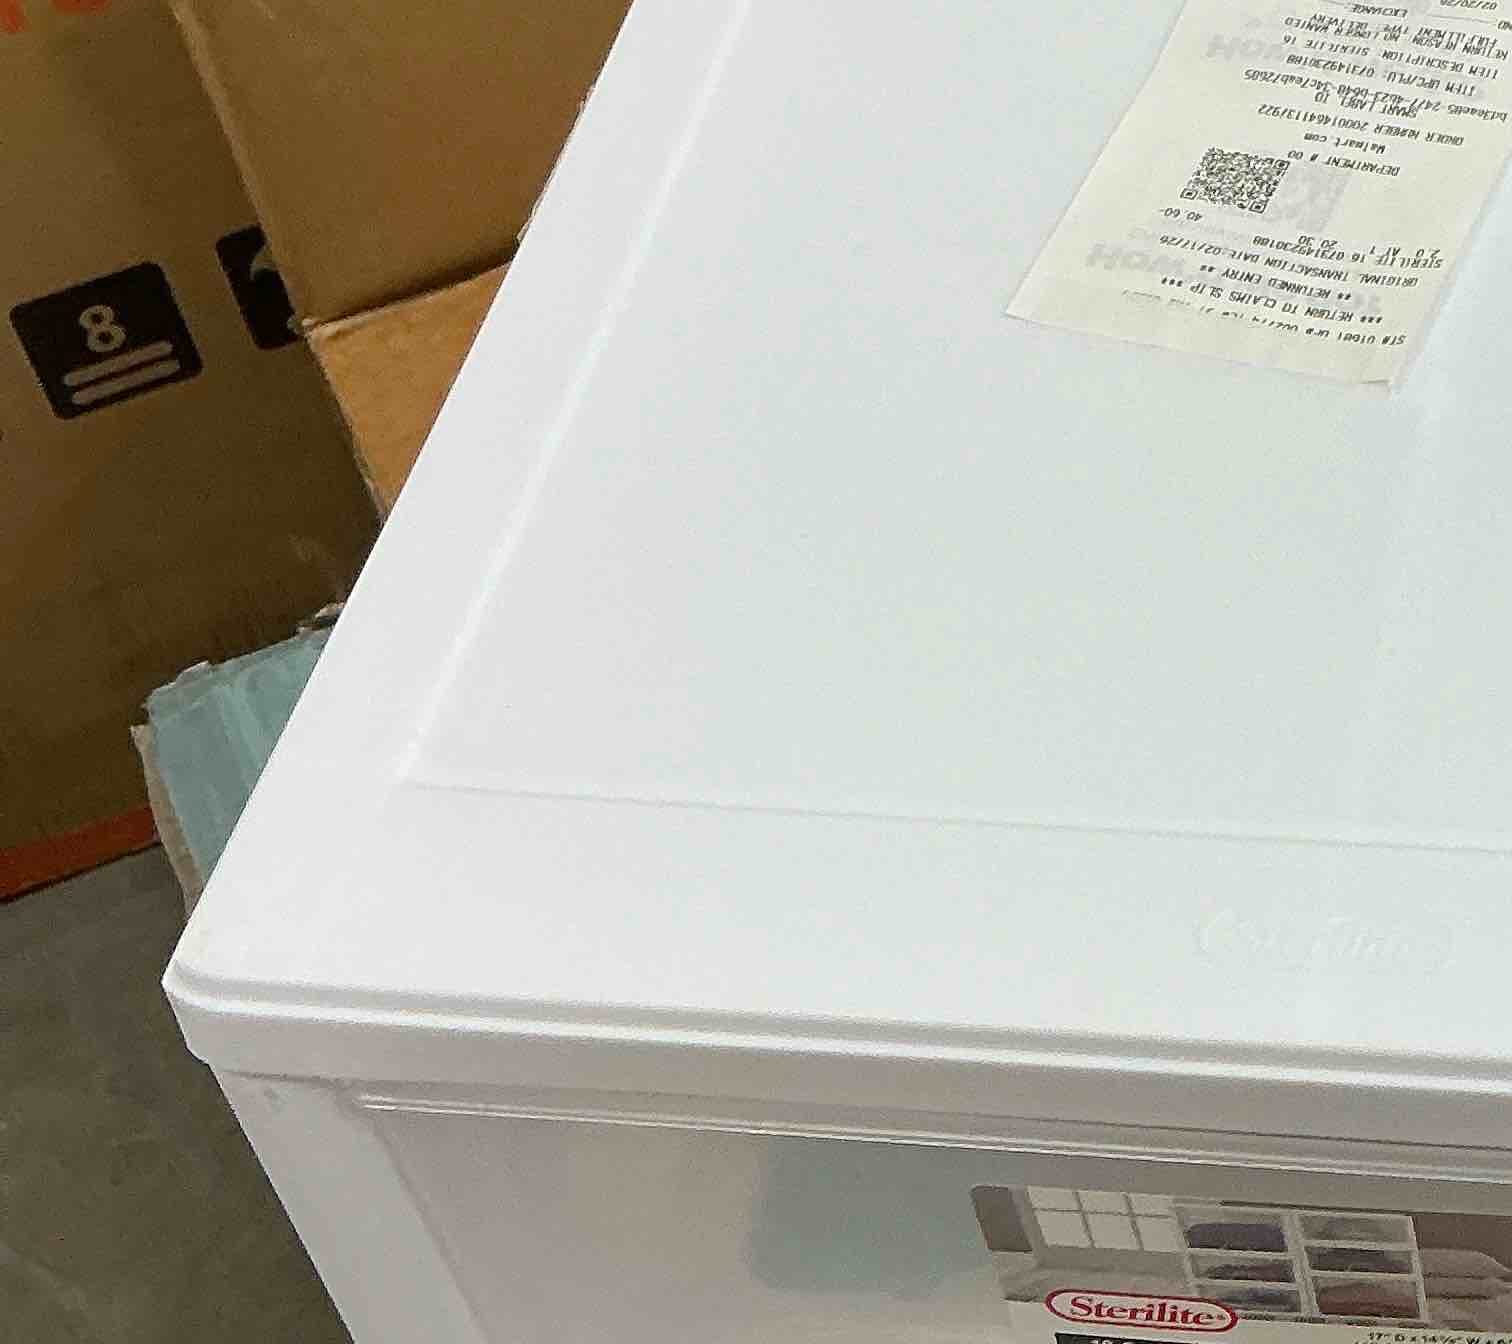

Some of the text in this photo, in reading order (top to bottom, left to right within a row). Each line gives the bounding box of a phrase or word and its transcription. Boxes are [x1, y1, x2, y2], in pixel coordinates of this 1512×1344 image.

[1322, 155, 1401, 176] DEPARTMENT
[1219, 267, 1263, 284] ENTRY
[1070, 1296, 1220, 1326] Sterilite
